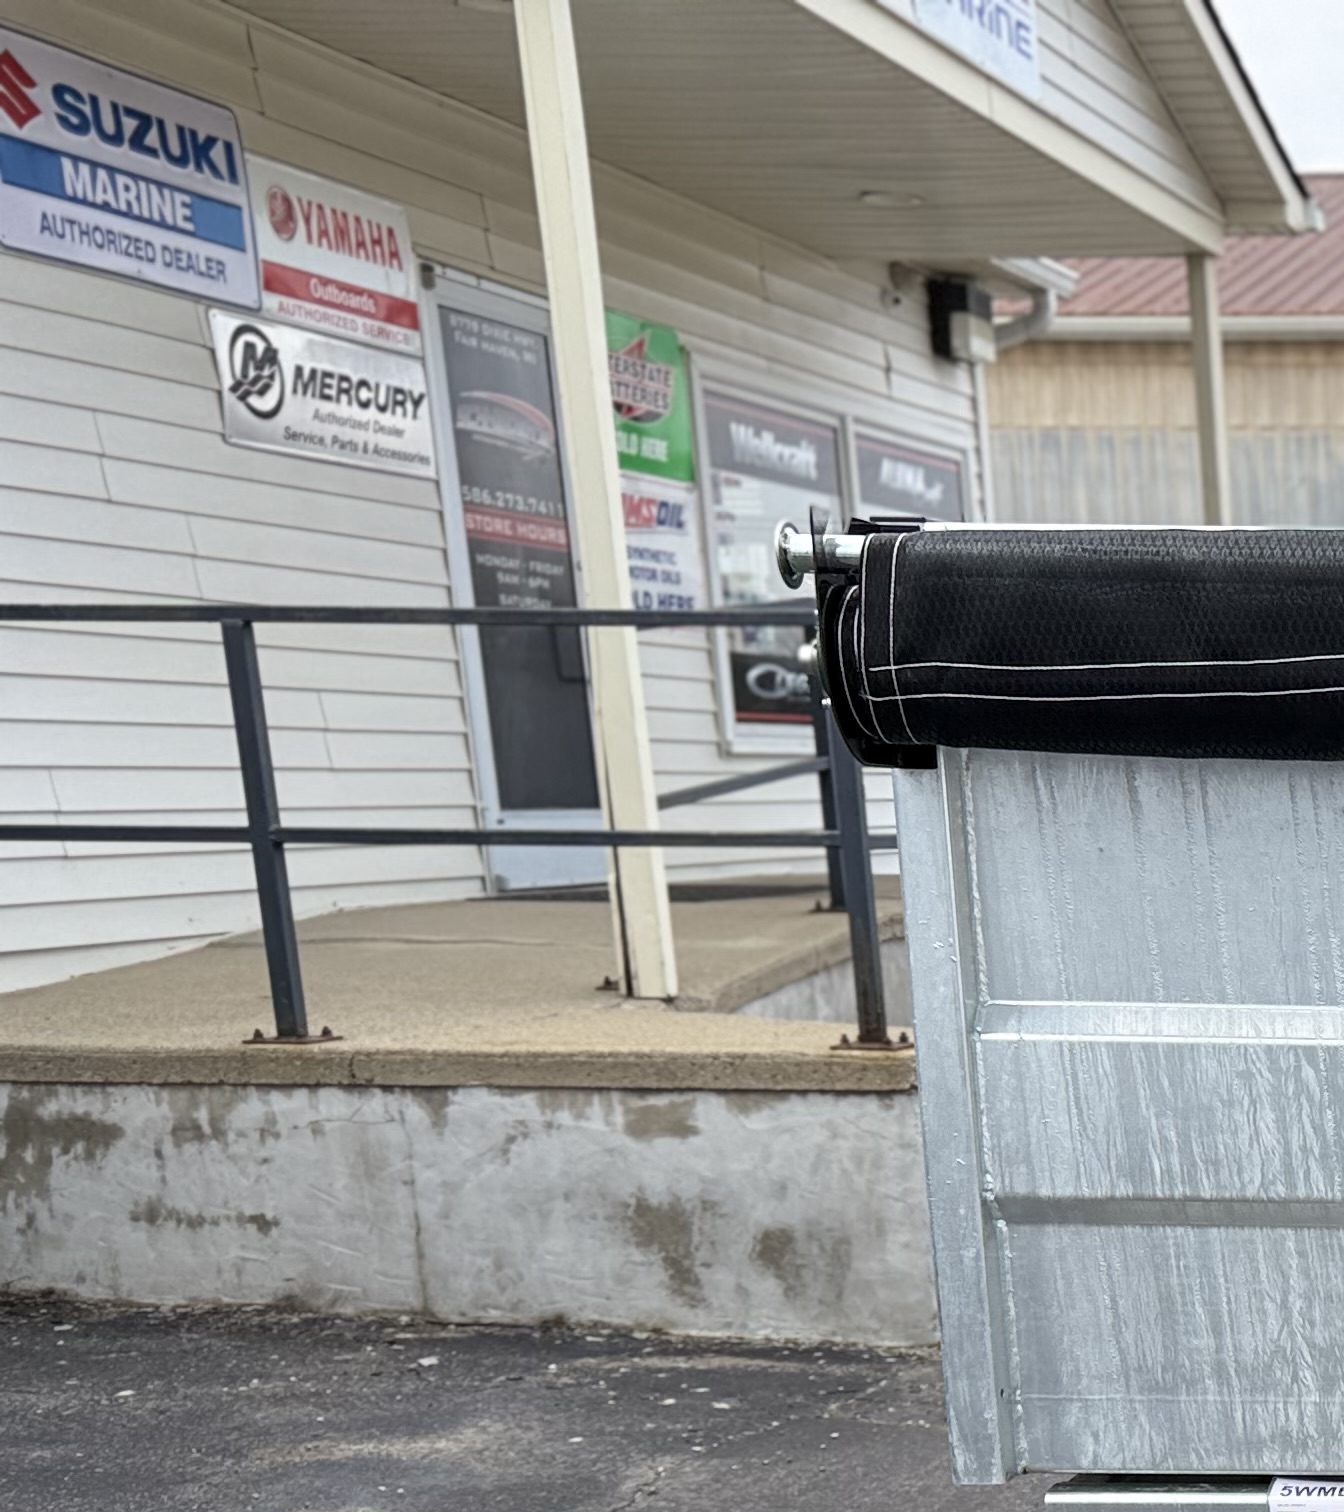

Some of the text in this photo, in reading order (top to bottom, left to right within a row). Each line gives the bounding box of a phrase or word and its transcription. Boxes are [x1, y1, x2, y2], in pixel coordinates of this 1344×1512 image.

[51, 82, 240, 185] SUZUKI
[60, 156, 195, 232] MARINE
[40, 211, 228, 284] AUTHORIZED DEALER
[296, 195, 403, 272] YAMAHA
[309, 277, 377, 314] Outboards
[278, 300, 412, 345] AUTHORIZED SERVICE
[608, 354, 672, 388] TERSTATE
[292, 363, 426, 421] MERCURY
[612, 381, 669, 411] TTERIES
[312, 408, 406, 438] Authorized Dealer
[283, 425, 328, 448] Service,
[331, 435, 359, 453] Parts
[372, 443, 431, 466] Accessories
[616, 430, 638, 456] OLD
[465, 512, 567, 545] STORE HOURS
[621, 493, 687, 529] MSOIL
[476, 553, 520, 569] MONDAY
[529, 560, 564, 576] FRIDAY
